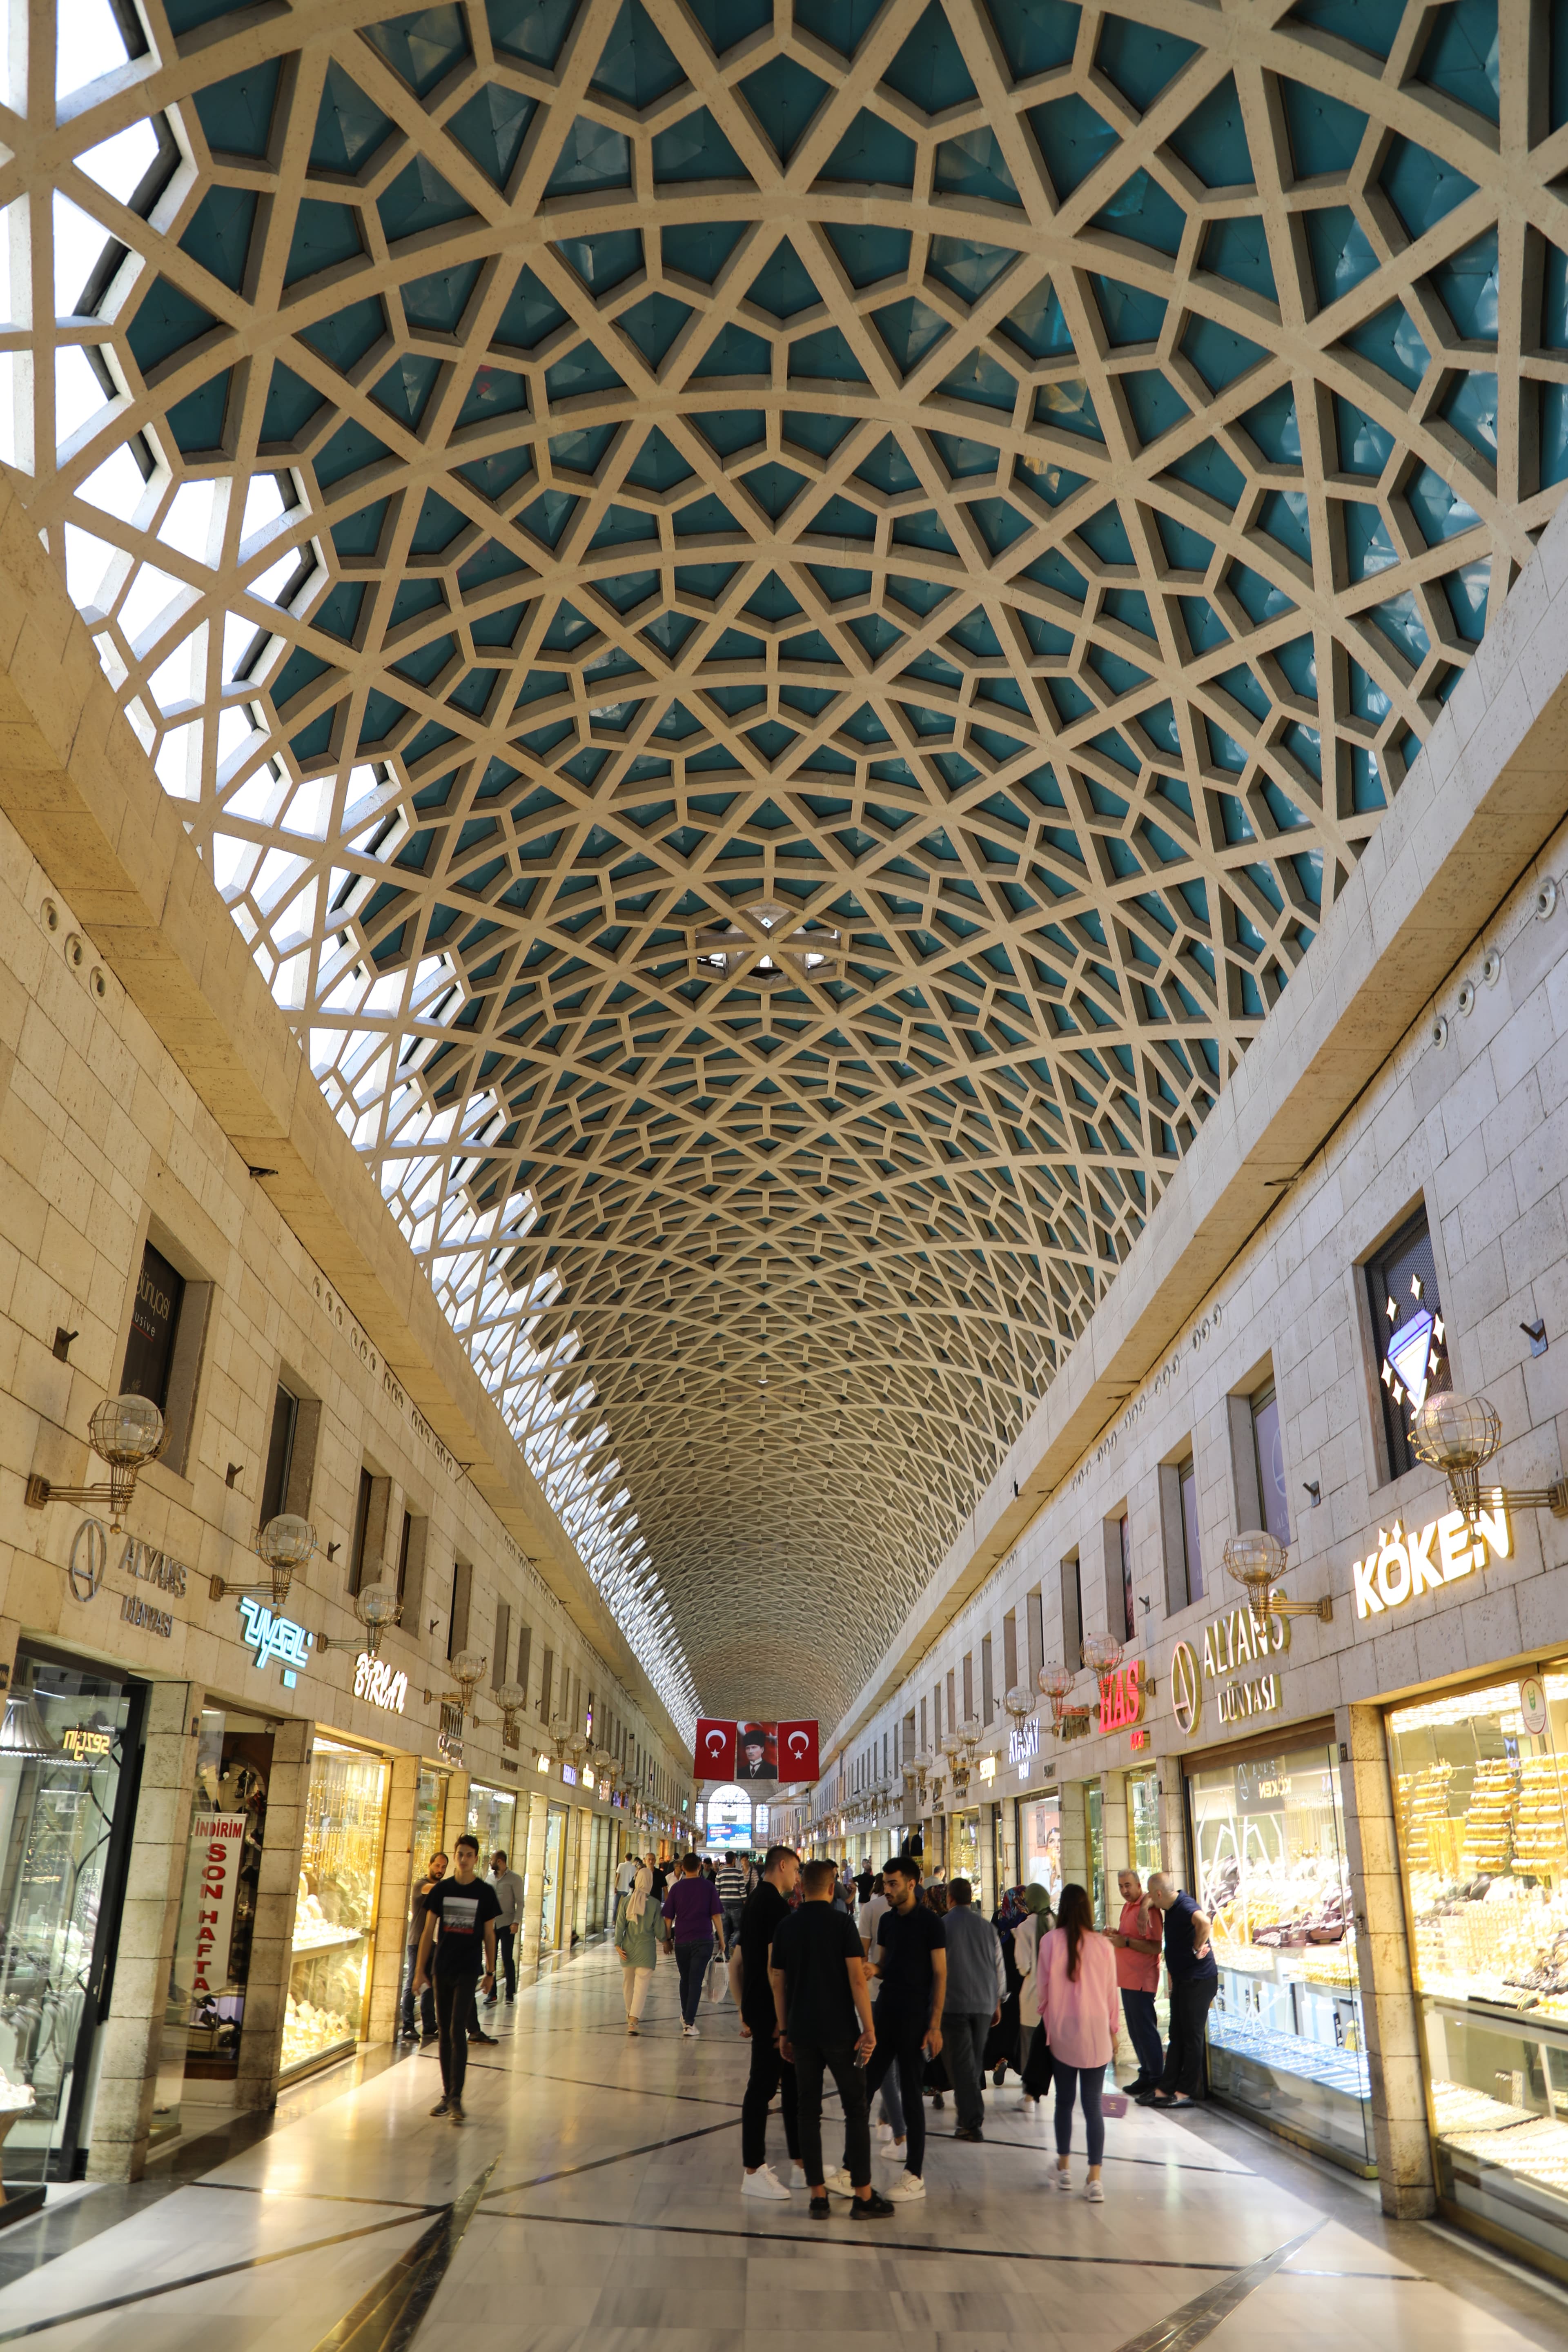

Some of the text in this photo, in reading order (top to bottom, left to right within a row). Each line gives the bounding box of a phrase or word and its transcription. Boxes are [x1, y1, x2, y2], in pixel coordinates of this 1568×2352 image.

[118, 1536, 187, 1599] ALYANS
[1353, 1487, 1509, 1619] KÖKEN
[120, 1595, 173, 1638] DÜNYASI
[1204, 1588, 1284, 1677] ALYANS
[1098, 1659, 1139, 1734] HAS
[1217, 1674, 1276, 1724] DÜNYASI
[1009, 1717, 1039, 1764] ATASAY
[195, 1817, 243, 1838] İNDİRİM
[200, 1843, 226, 1899] SON
[192, 1910, 218, 1991] HAFTA
